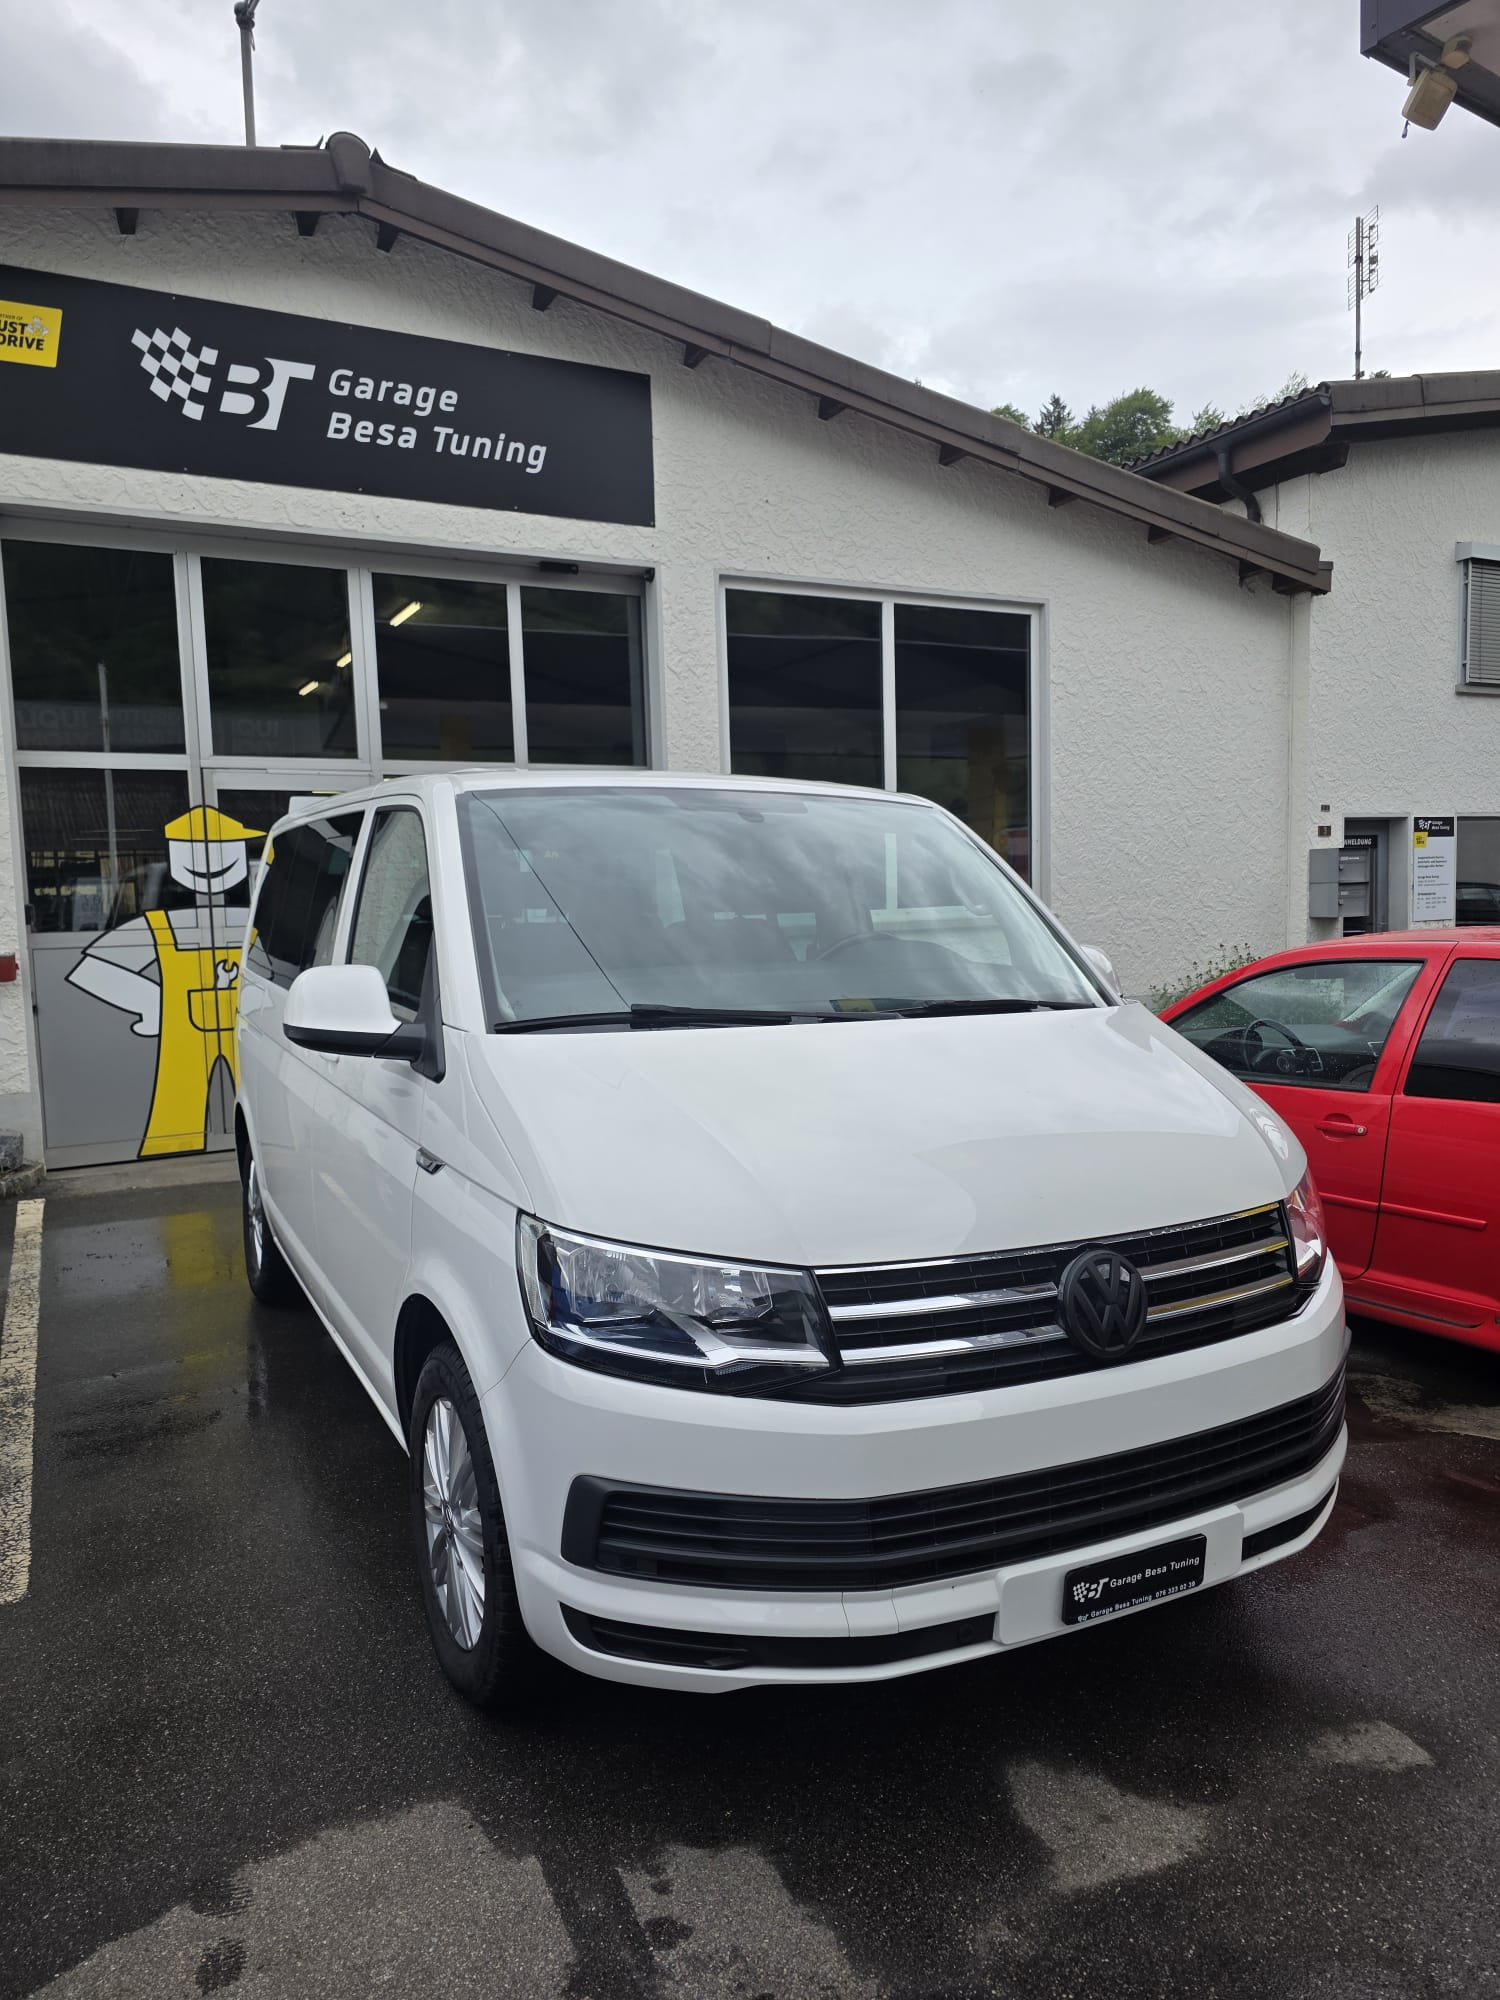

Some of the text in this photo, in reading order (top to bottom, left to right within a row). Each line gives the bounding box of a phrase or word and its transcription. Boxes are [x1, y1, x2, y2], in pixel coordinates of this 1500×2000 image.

[0, 319, 28, 335] UST
[328, 368, 459, 417] Garage
[326, 411, 547, 474] Besa Tuning
[1344, 838, 1372, 846] NMELDUNG
[1110, 1573, 1143, 1588] Garage
[1145, 1566, 1167, 1578] Besa
[1170, 1557, 1200, 1571] Tuning
[1090, 1606, 1113, 1617] Garage
[1132, 1595, 1152, 1605] Tuning
